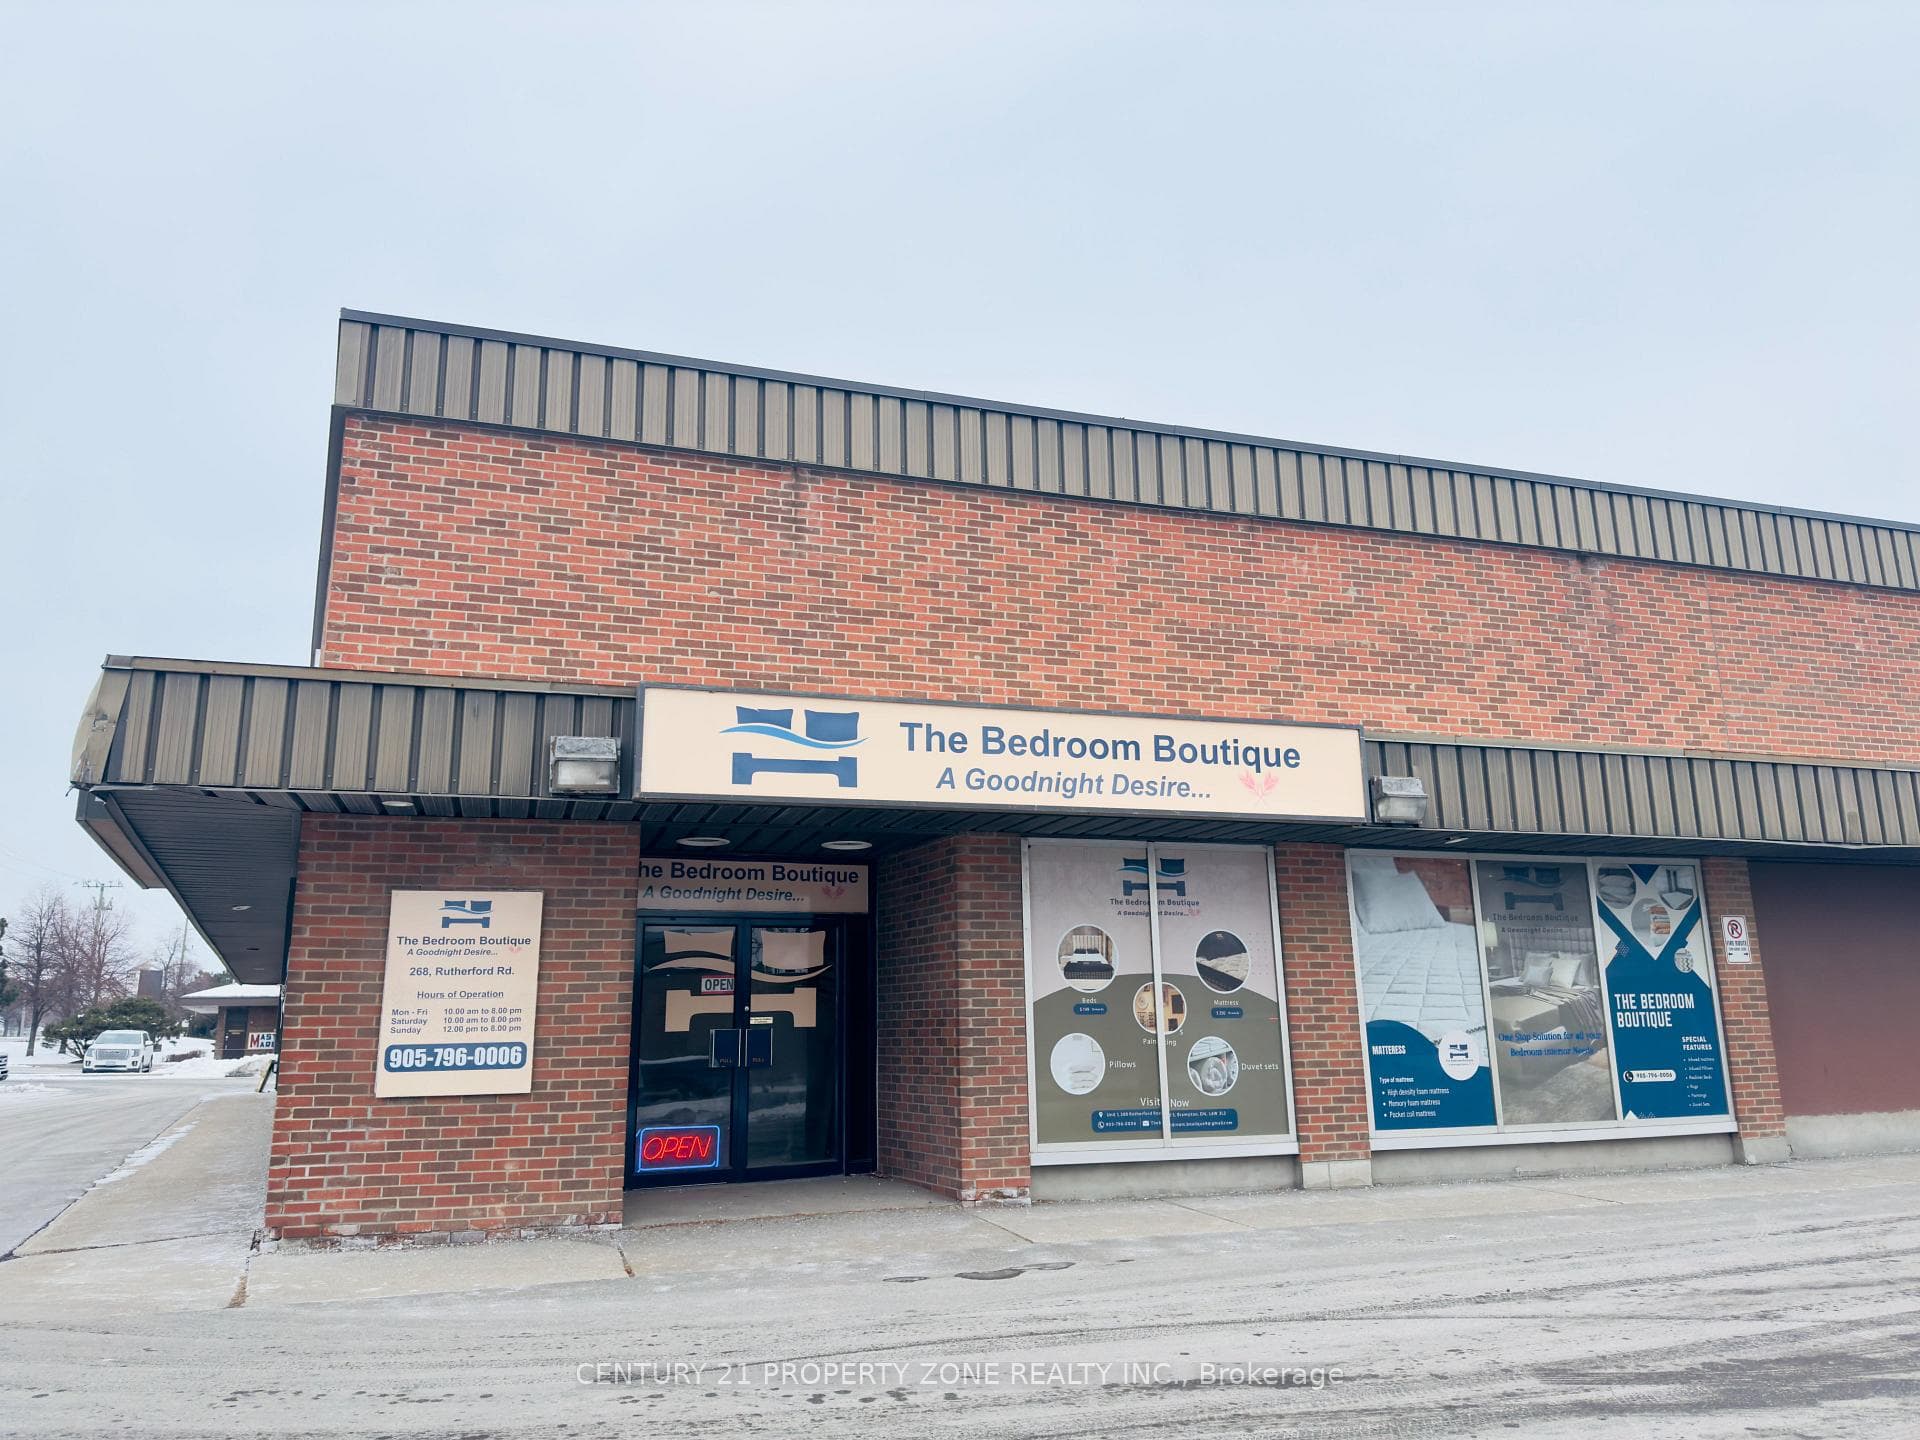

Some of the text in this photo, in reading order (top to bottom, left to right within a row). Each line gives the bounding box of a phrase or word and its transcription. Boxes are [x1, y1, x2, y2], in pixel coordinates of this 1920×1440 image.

[900, 722, 1300, 773] The Bedroom Boutique
[936, 767, 1211, 799] A Goodnight Desire...
[639, 862, 859, 886] he Bedroom Boutique
[643, 886, 804, 903] A Goodnight Desire...
[1167, 899, 1199, 907] Boutique
[397, 936, 531, 947] The Bedroom Boutique
[416, 949, 461, 957] Goodnight
[409, 966, 515, 977] 268, Rutherford Rd.
[705, 979, 733, 990] OPEN
[417, 991, 445, 999] Hours
[459, 991, 504, 999] Operation
[1615, 993, 1694, 1009] THE BEDROOM
[391, 1018, 427, 1026] Saturday
[1617, 1011, 1672, 1028] BOUTIQUE
[390, 1026, 421, 1034] Sunday
[1515, 1033, 1530, 1042] Stop
[1533, 1032, 1561, 1040] Solution
[389, 1046, 522, 1067] 905-796-0006
[1511, 1048, 1542, 1056] Bedroom
[1141, 1098, 1189, 1107] Visit Now
[1389, 1100, 1406, 1108] Memory
[644, 1134, 712, 1160] OPEN
